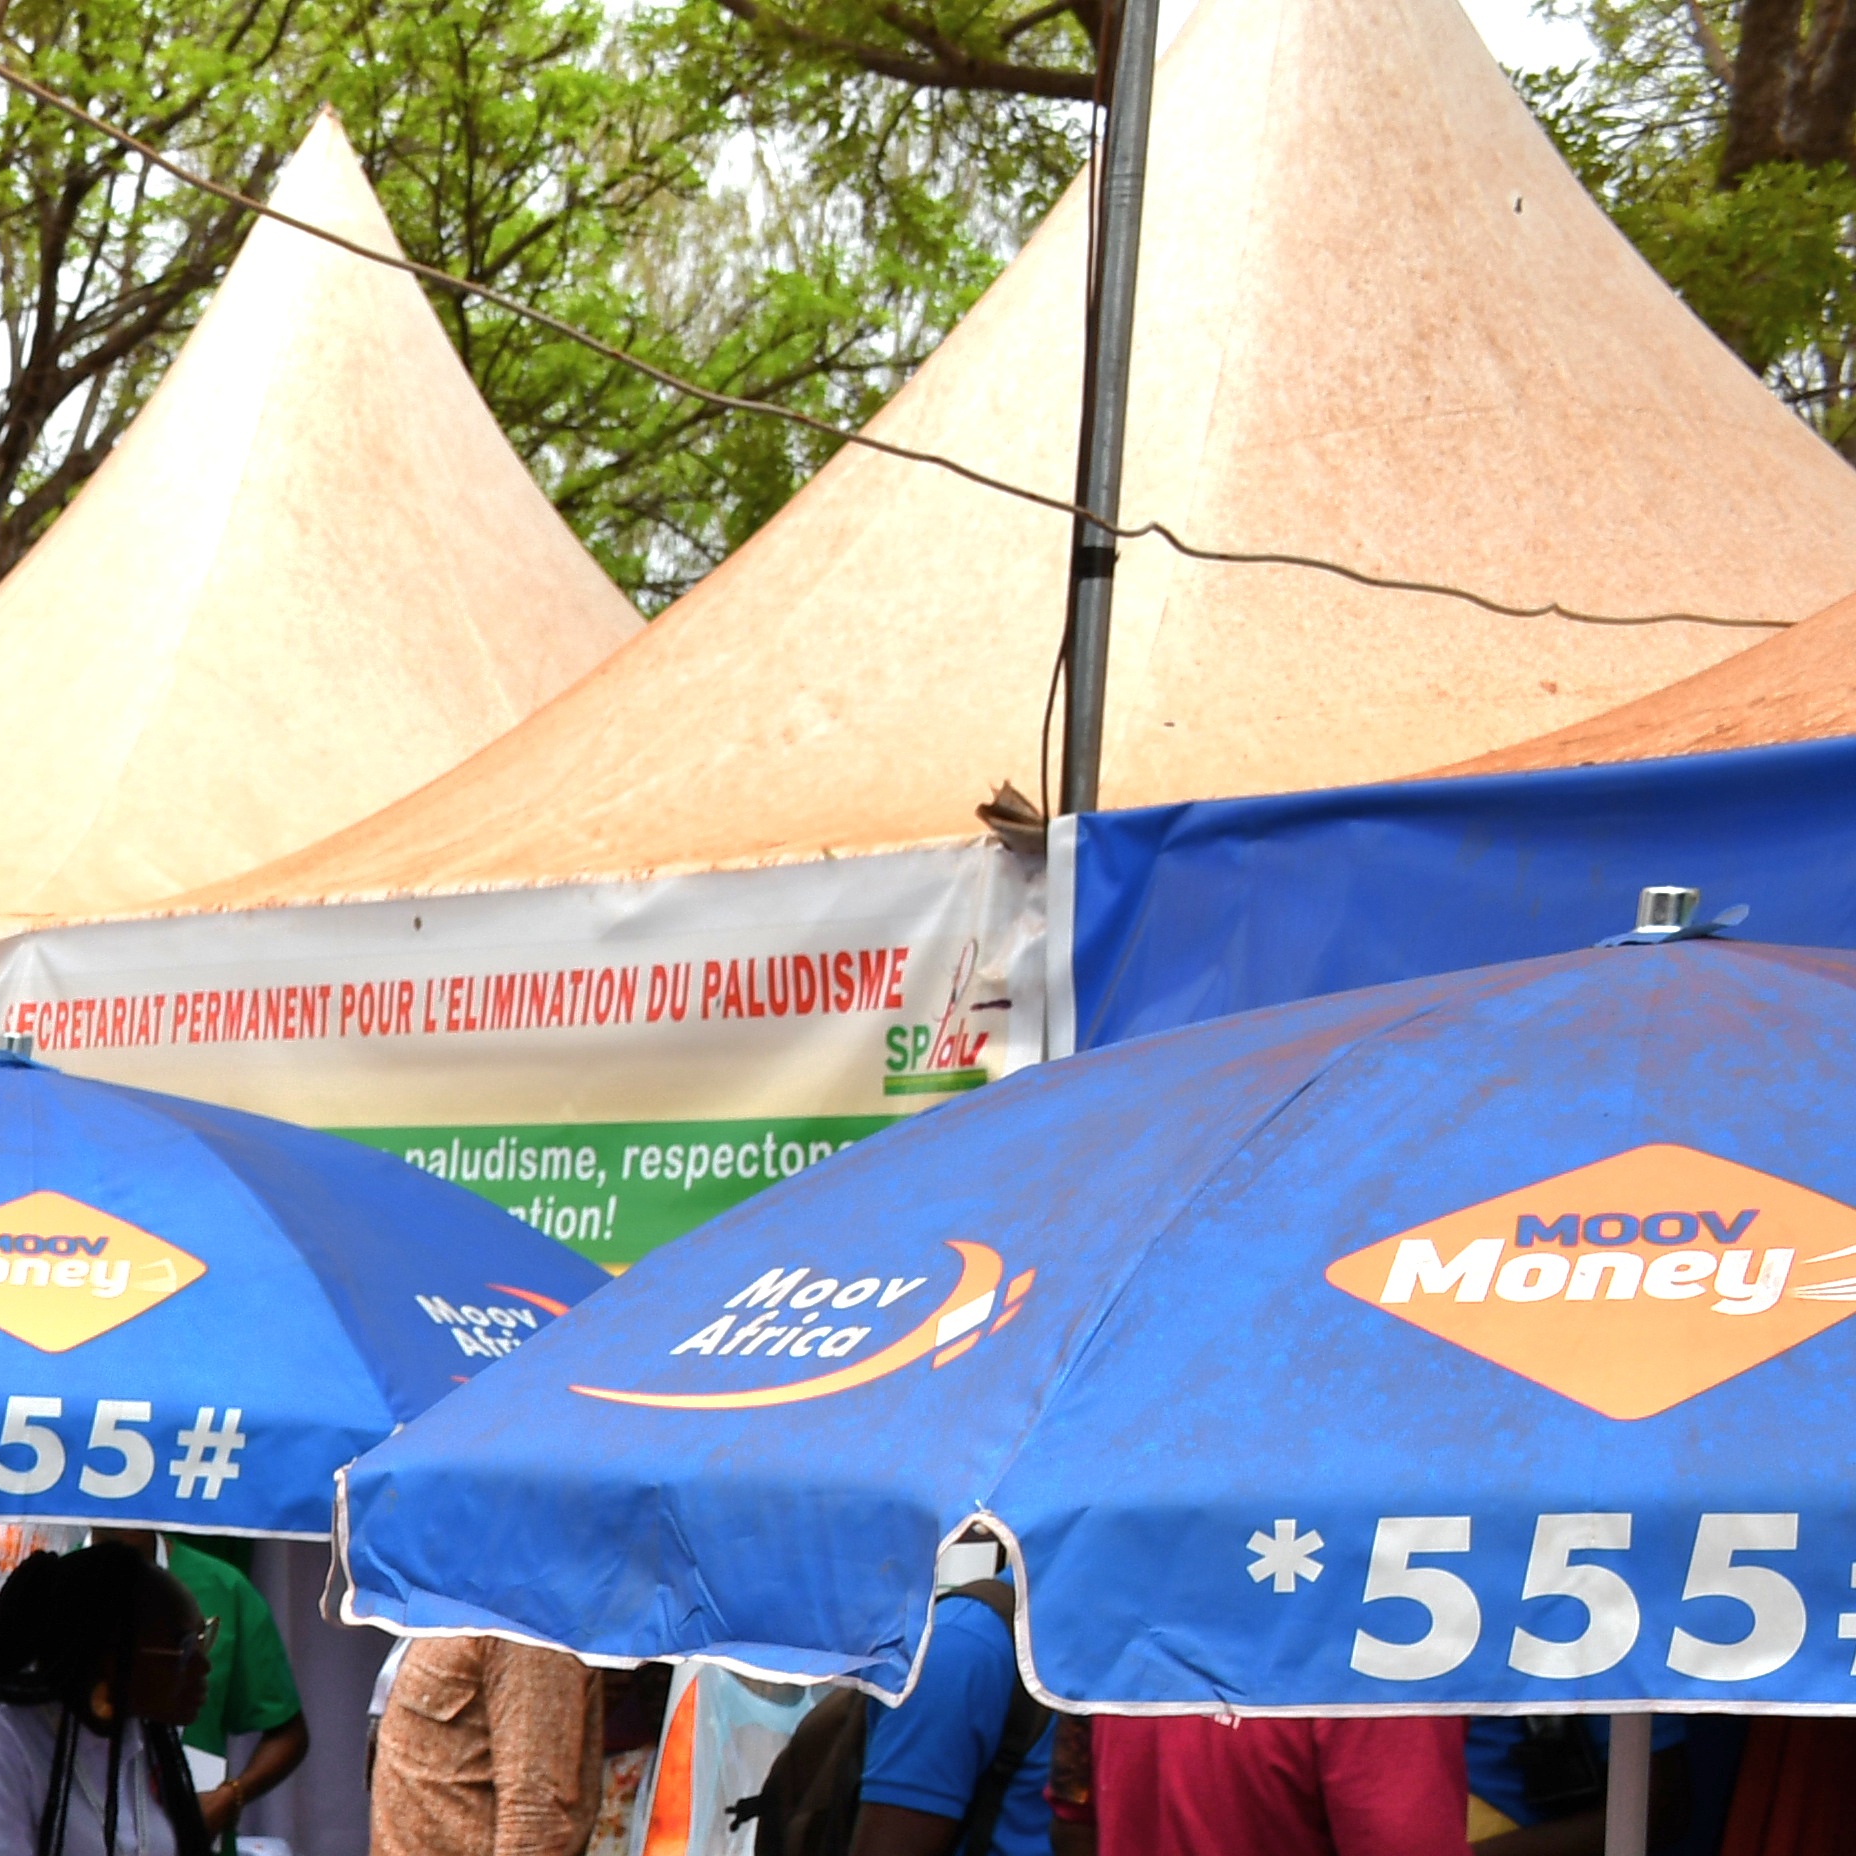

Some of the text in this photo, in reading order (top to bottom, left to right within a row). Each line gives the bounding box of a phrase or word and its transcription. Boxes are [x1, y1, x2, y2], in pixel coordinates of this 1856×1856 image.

[171, 984, 332, 1045] PERMANENT
[339, 980, 414, 1037] POUR
[423, 966, 638, 1034] L'ELIMINATION
[646, 962, 692, 1023] DU
[701, 947, 910, 1020] PALUDISME
[1513, 1207, 1761, 1248] MOOV
[724, 1266, 928, 1315] Moov
[1378, 1238, 1796, 1315] Money
[415, 1294, 538, 1330] Moov
[671, 1312, 874, 1361] Africa
[1246, 1511, 1856, 1683] 555
